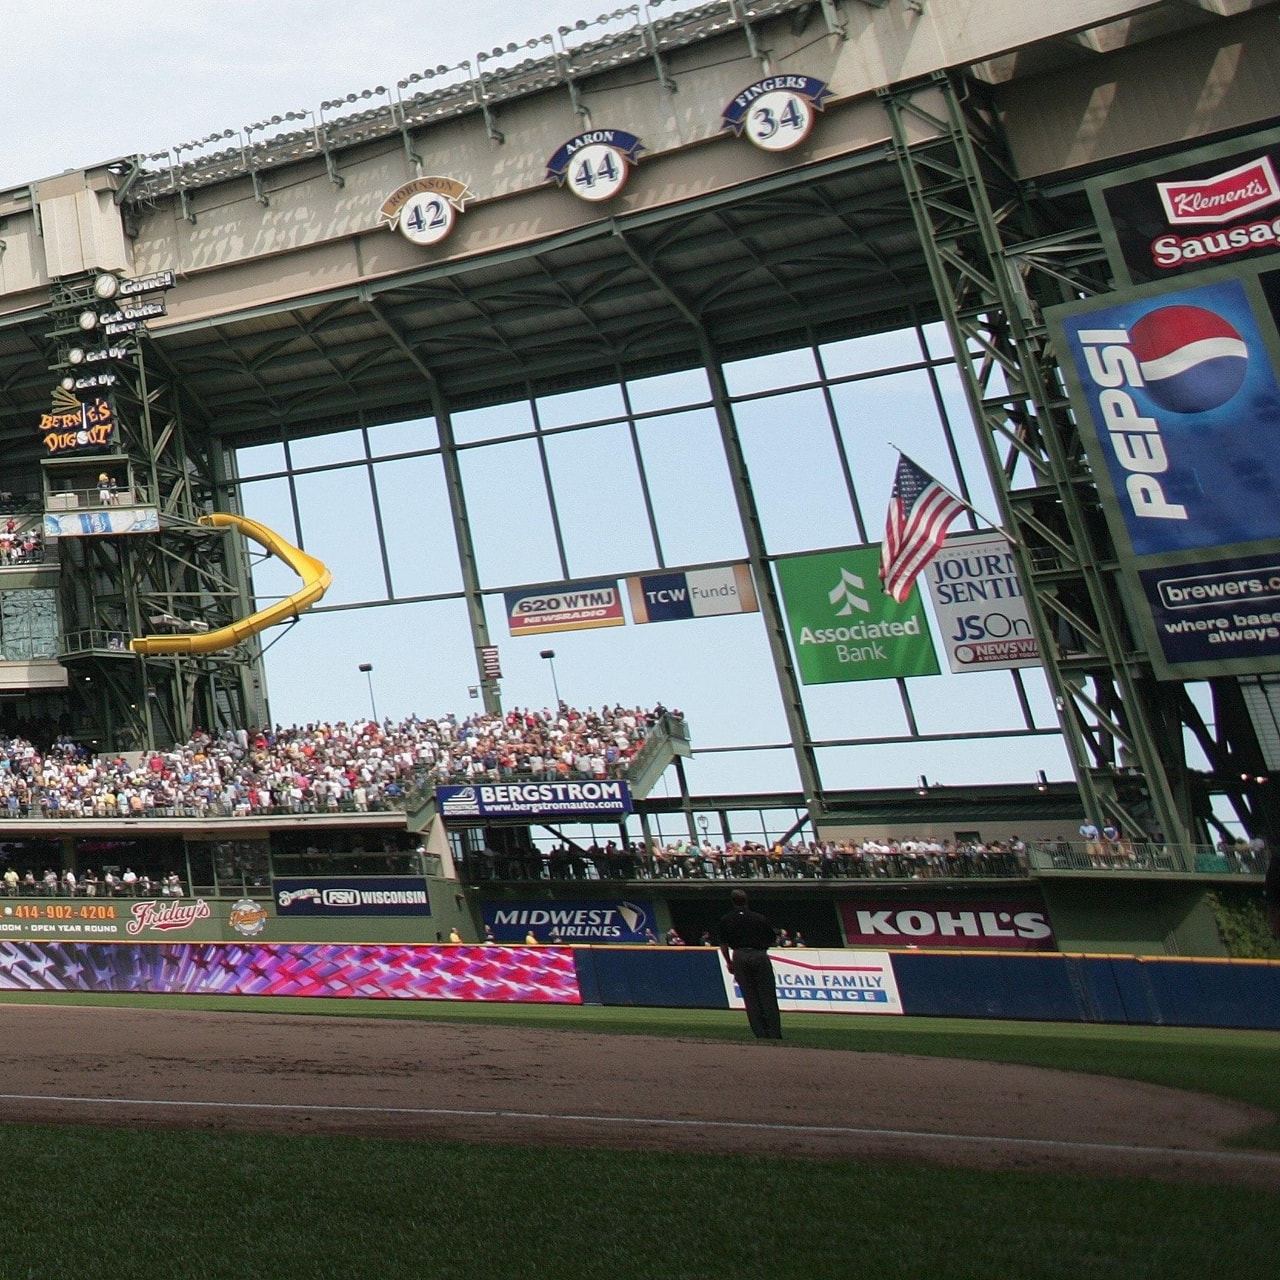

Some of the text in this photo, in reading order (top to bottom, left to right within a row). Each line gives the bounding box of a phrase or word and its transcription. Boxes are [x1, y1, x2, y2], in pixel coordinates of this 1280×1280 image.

[735, 76, 807, 107] FINGERS
[753, 97, 804, 140] 34
[566, 131, 615, 155] AARON
[576, 151, 619, 188] 44
[390, 179, 453, 206] ROBINSON
[1175, 179, 1267, 215] Klement's
[407, 200, 447, 232] 42
[120, 272, 172, 294] Gone!
[100, 303, 163, 324] Get Outta
[106, 321, 137, 335] Here
[86, 347, 126, 362] Get Up
[75, 377, 97, 389] Get
[39, 398, 113, 430] BERNIE'S
[1077, 329, 1188, 520] PEPSI
[43, 424, 113, 452] DUGOUT
[518, 590, 613, 613] 620 WTMJ
[647, 583, 737, 604] TCW Funds
[523, 609, 607, 624] NEWSRADIO
[1165, 618, 1229, 633] where
[800, 615, 920, 645] Associated
[1208, 627, 1279, 643] always
[836, 641, 887, 663] Bank
[480, 783, 622, 803] BERGSTROM
[483, 800, 623, 813] www.bergstromauto.com
[329, 891, 354, 904] FSN
[361, 891, 427, 904] WISCONSIN
[15, 905, 115, 919] 414-902-4204
[126, 898, 210, 934] Friday's
[494, 910, 617, 925] MIDWEST
[58, 924, 81, 932] YEAR
[84, 924, 118, 932] ROUND
[552, 926, 621, 937] AIRLINES
[856, 910, 1051, 939] KOHL'S
[778, 973, 882, 988] ICAN FAMILY
[776, 989, 875, 1001] SURANCE
